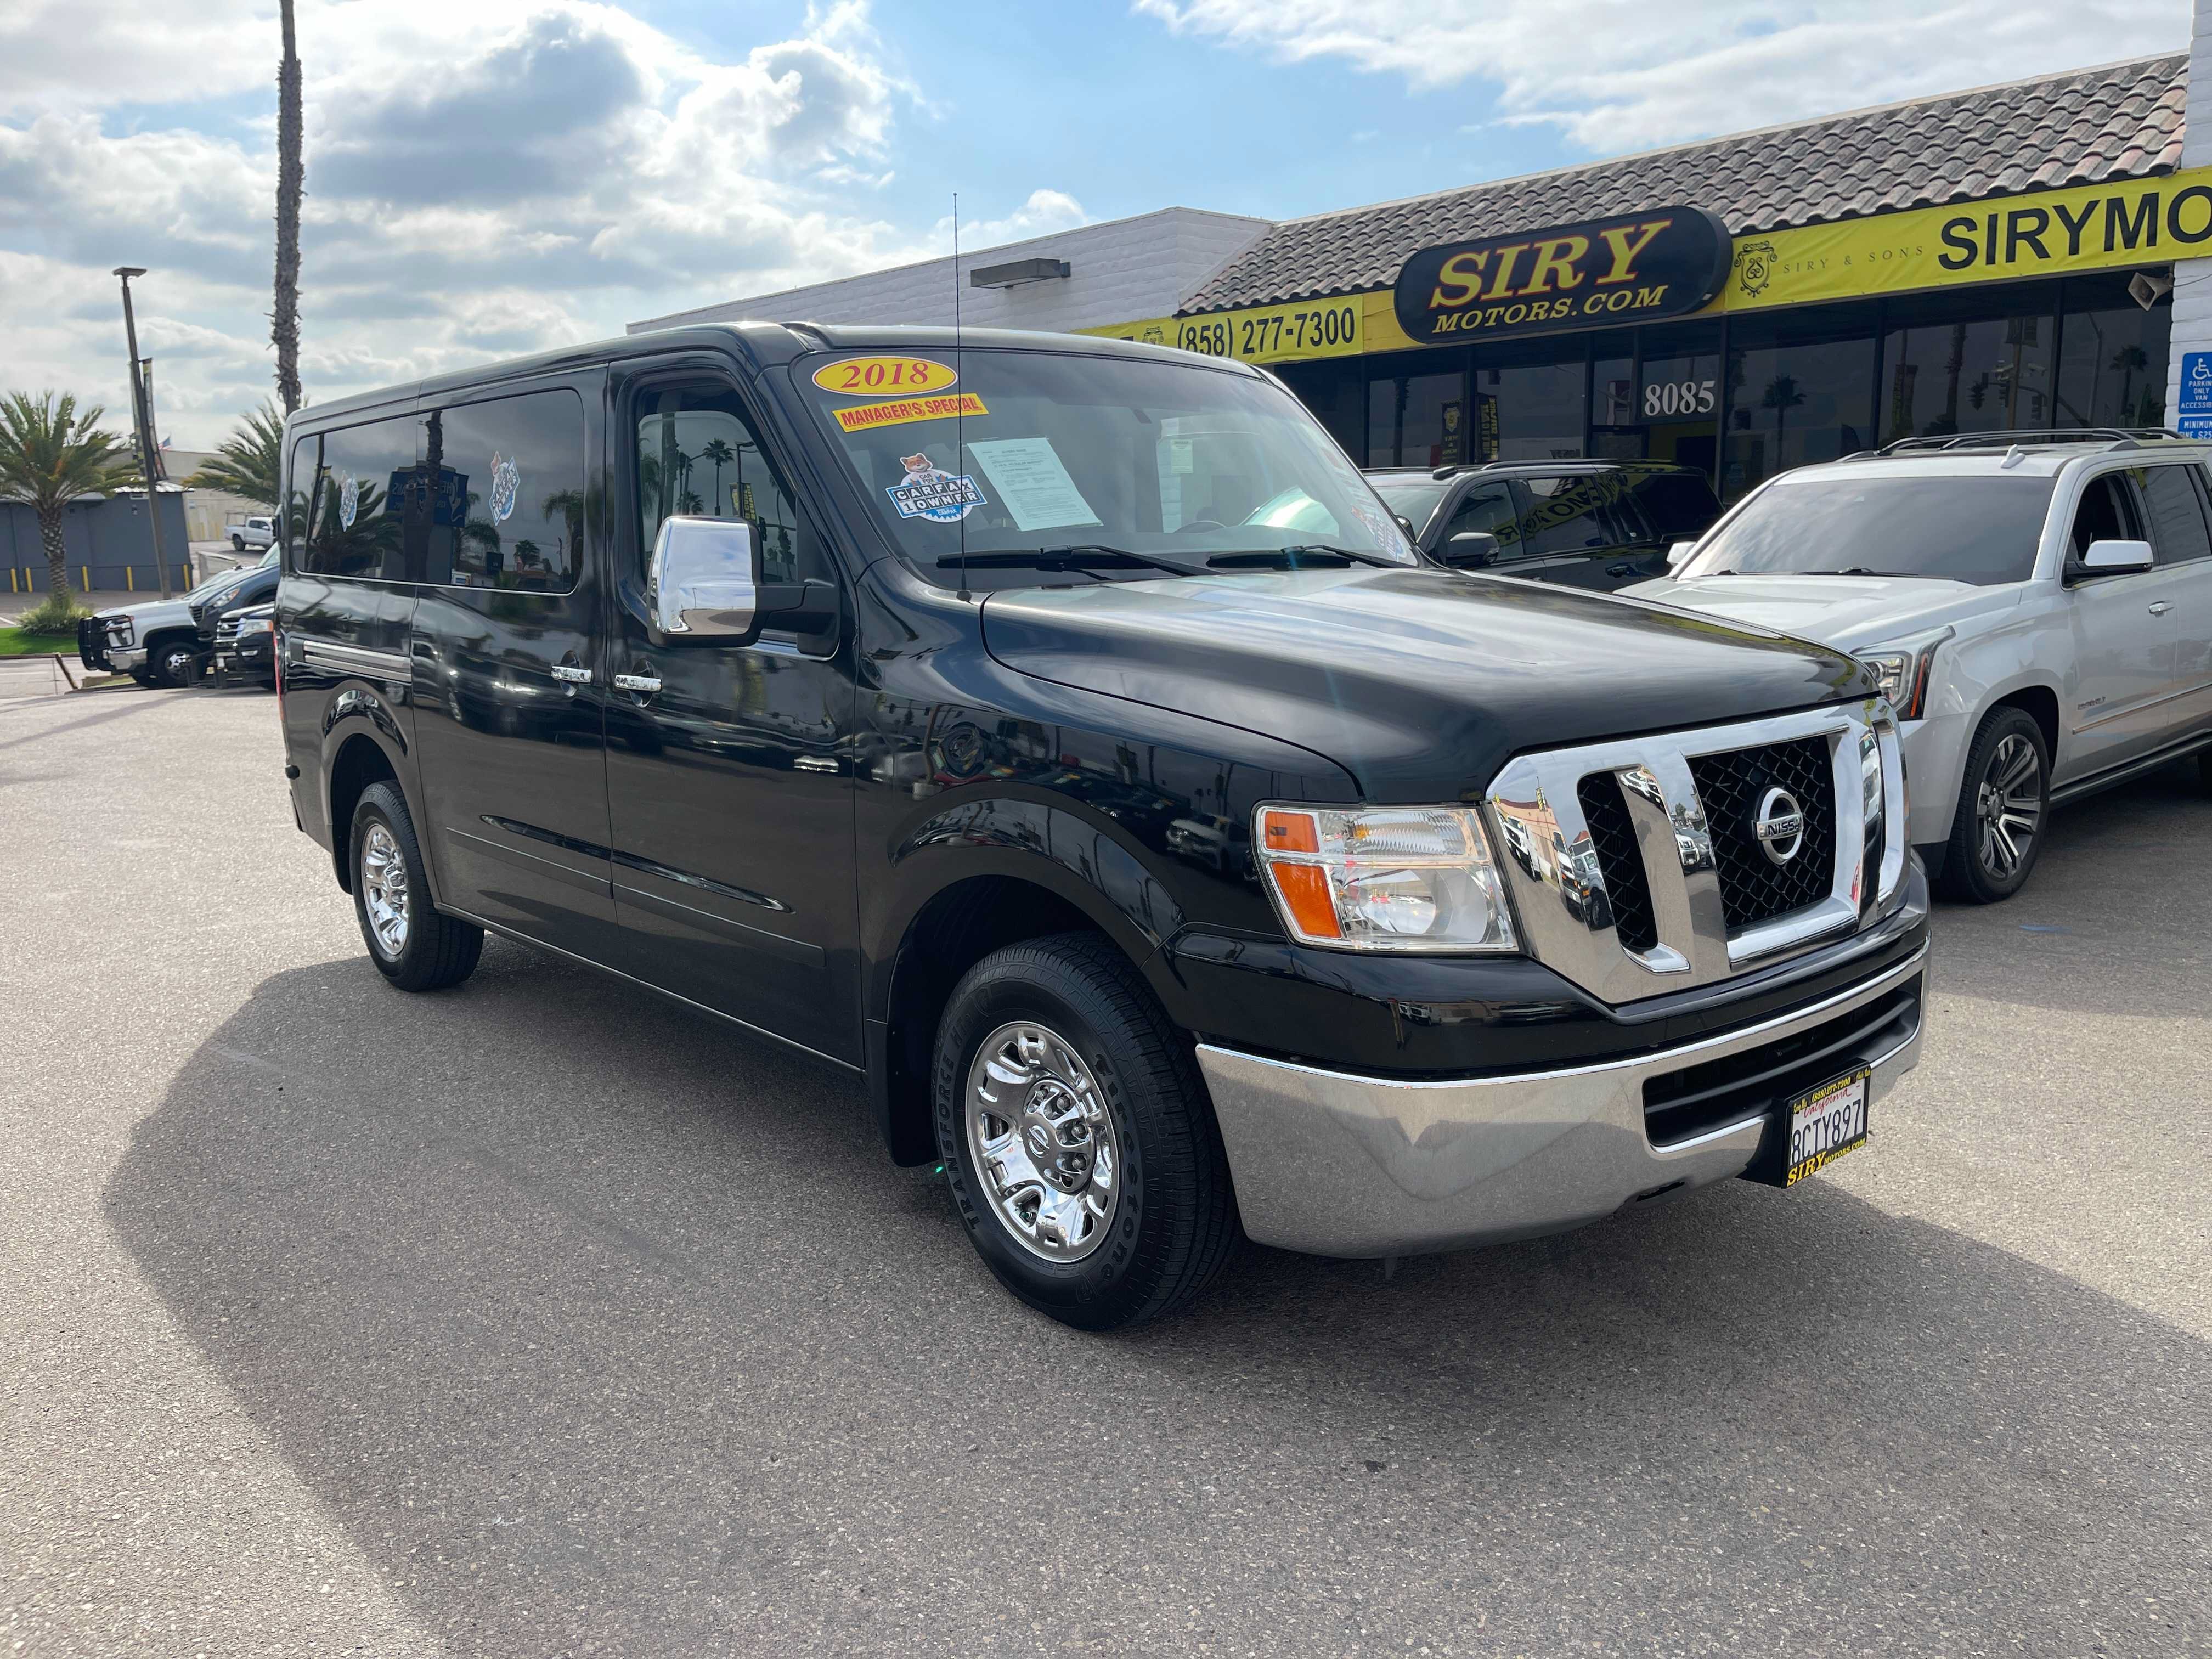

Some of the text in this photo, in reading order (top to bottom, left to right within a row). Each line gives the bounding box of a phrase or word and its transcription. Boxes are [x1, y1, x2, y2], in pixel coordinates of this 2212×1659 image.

[1938, 185, 2212, 270] SIRYMO
[1429, 219, 1673, 309] SIRY
[1784, 246, 1923, 273] SIRY & SONS
[1432, 285, 1668, 334] MOTORS.COM
[1178, 307, 1355, 358] (858) 277-7300
[840, 363, 928, 388] 2018
[840, 397, 981, 427] MANAGER'S SPECIAL
[1645, 381, 1716, 416] 8085
[896, 481, 972, 499] CARFAX
[1767, 816, 1801, 837] NISSA
[1804, 1087, 1853, 1118] California
[937, 1052, 981, 1231] TRANSFORCE
[1792, 1098, 1861, 1164] 8CTY897
[1787, 1137, 1866, 1187] SIRY MOTORS.COM
